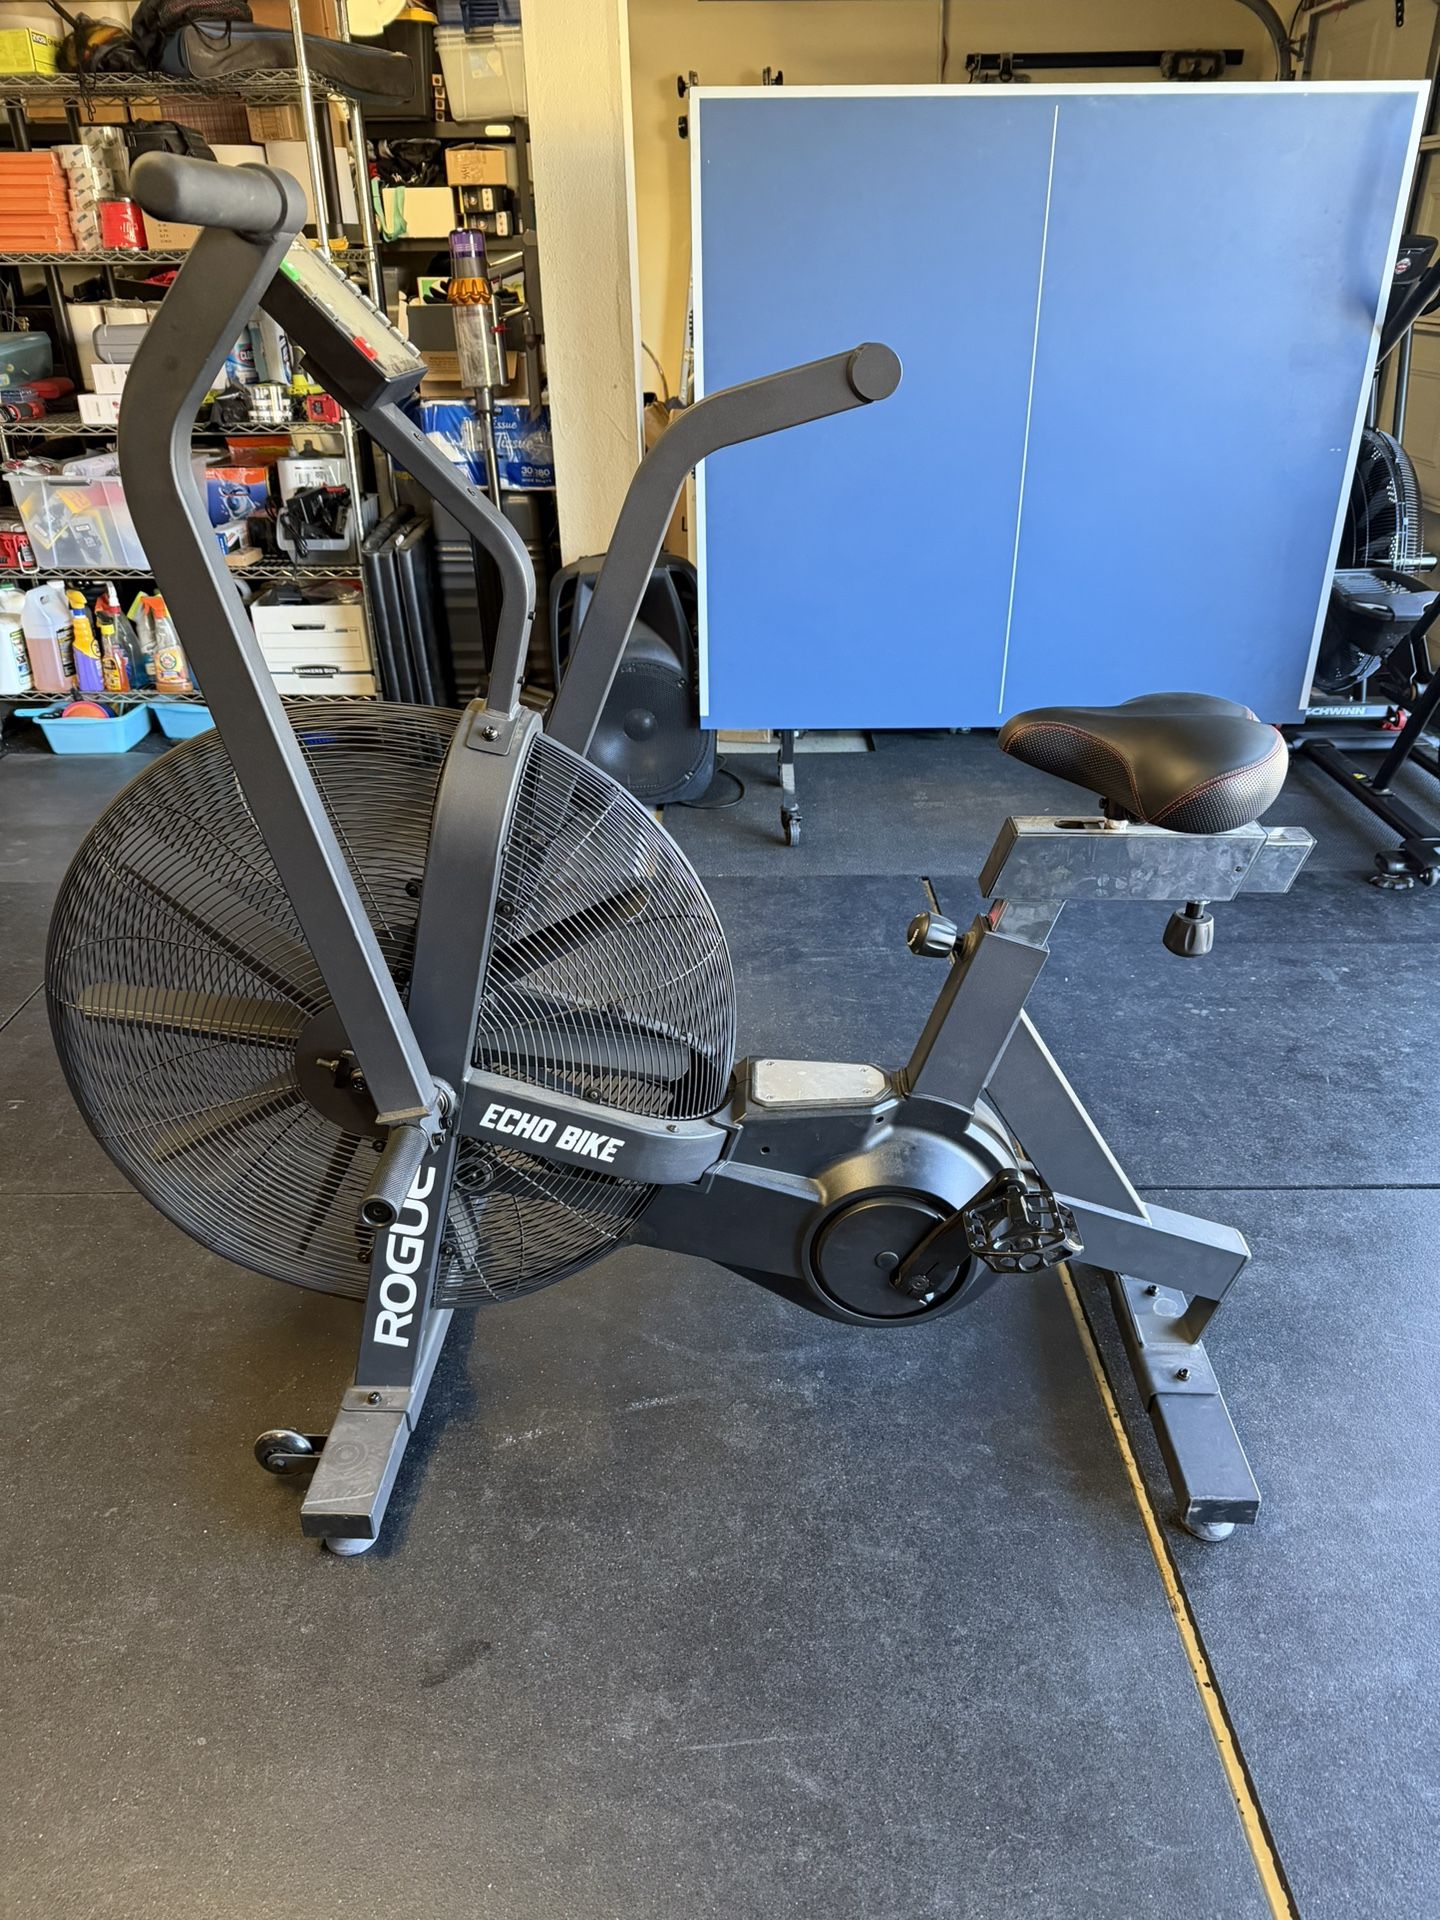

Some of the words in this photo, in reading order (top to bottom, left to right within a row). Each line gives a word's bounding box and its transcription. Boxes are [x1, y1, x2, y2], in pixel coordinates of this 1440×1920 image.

[1306, 707, 1366, 716] SCHWINN
[479, 1103, 557, 1143] ECHO
[555, 1125, 626, 1163] BIKE
